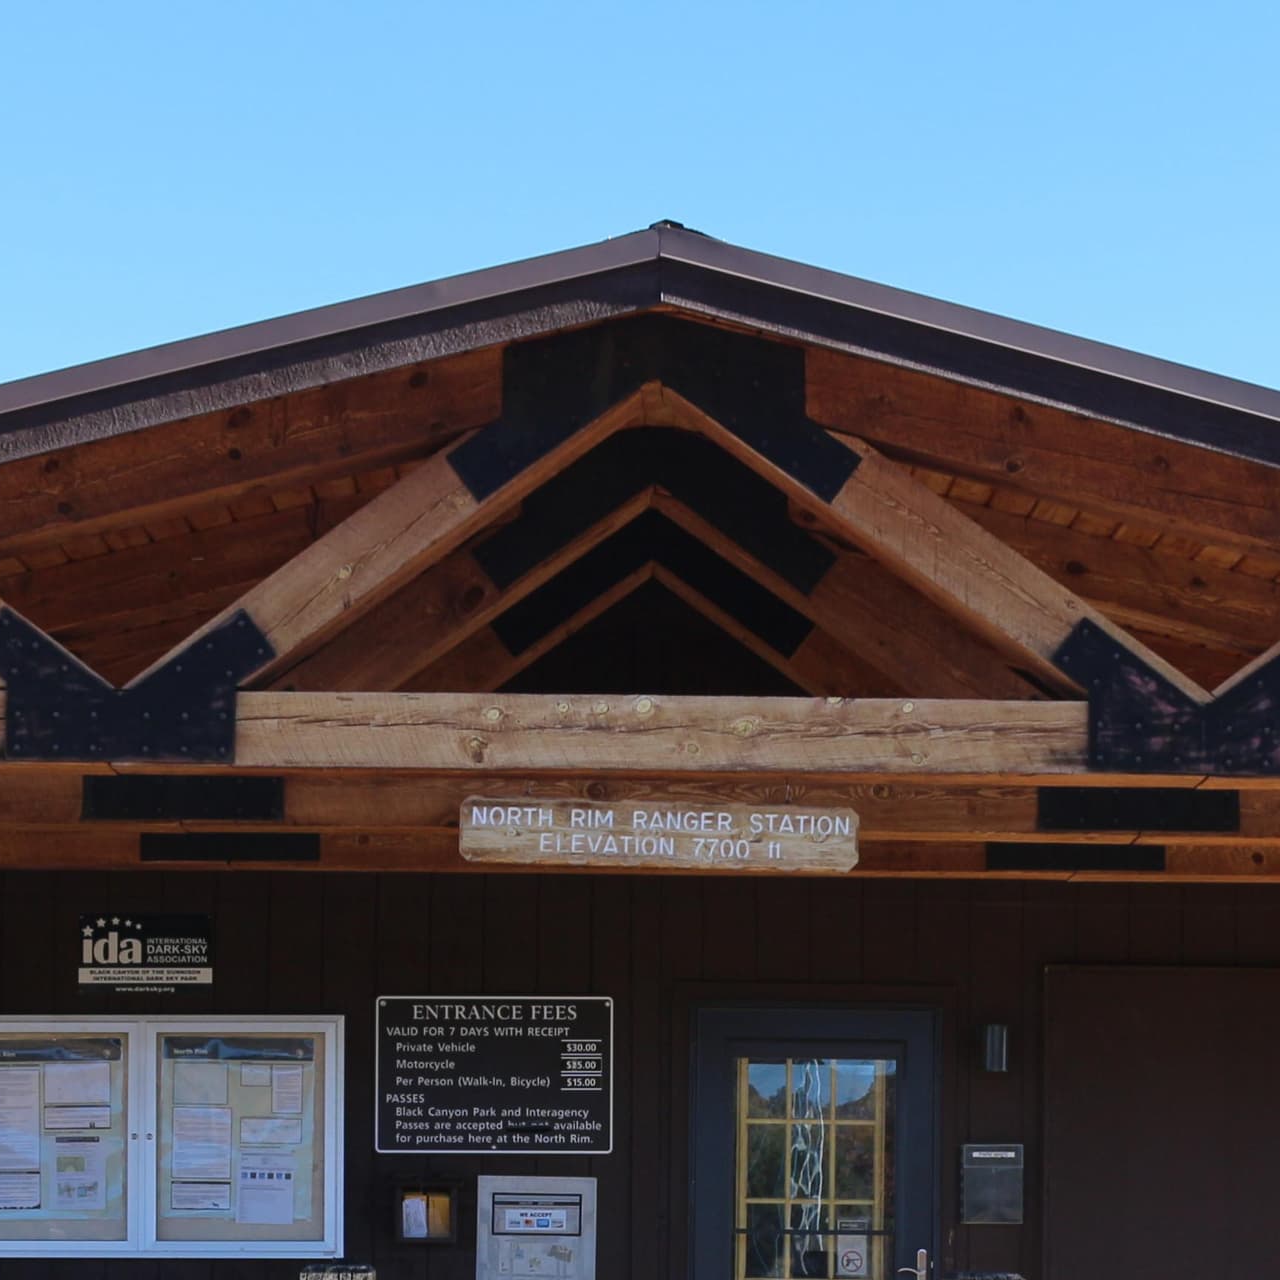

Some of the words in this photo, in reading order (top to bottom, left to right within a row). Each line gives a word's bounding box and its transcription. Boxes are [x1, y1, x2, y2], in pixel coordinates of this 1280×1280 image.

[471, 807, 553, 827] NORTH
[571, 809, 613, 828] RIM
[633, 810, 732, 832] RANGER
[750, 813, 850, 835] STATION
[540, 833, 674, 856] ELEVATION
[693, 837, 749, 858] 7700
[82, 930, 142, 964] ida
[147, 945, 207, 954] DARK-SKY
[147, 955, 207, 963] ASSOCIATION
[413, 1005, 523, 1020] ENTRANCE
[531, 1005, 577, 1020] FEES
[387, 1027, 418, 1036] VALID
[423, 1027, 444, 1036] FOR
[449, 1027, 455, 1036] 7
[460, 1027, 489, 1036] DAYS
[494, 1027, 523, 1036] WITH
[527, 1027, 570, 1037] RECEIPT
[396, 1043, 433, 1052] Private
[438, 1043, 476, 1052] Vehicle
[566, 1043, 597, 1052] $30.00
[396, 1060, 455, 1071] Motorcycle
[396, 1077, 413, 1086] Per
[418, 1077, 453, 1087] Person
[458, 1077, 506, 1088] (Walk-In,
[510, 1077, 551, 1088] Bicycle)
[566, 1078, 597, 1087] $15.00
[386, 1094, 425, 1103] PASSES
[396, 1108, 423, 1117] Black
[428, 1108, 468, 1119] Canyon
[473, 1108, 496, 1117] Park
[501, 1108, 521, 1117] and
[526, 1108, 589, 1120] Interagency
[396, 1121, 429, 1130] Passes
[456, 1120, 503, 1132] accepted
[553, 1121, 602, 1131] available
[396, 1134, 411, 1143] for
[416, 1134, 464, 1145] purchase
[468, 1134, 492, 1143] here
[497, 1135, 508, 1143] at
[512, 1134, 530, 1143] the
[534, 1134, 565, 1143] North
[570, 1134, 594, 1144] Rim.
